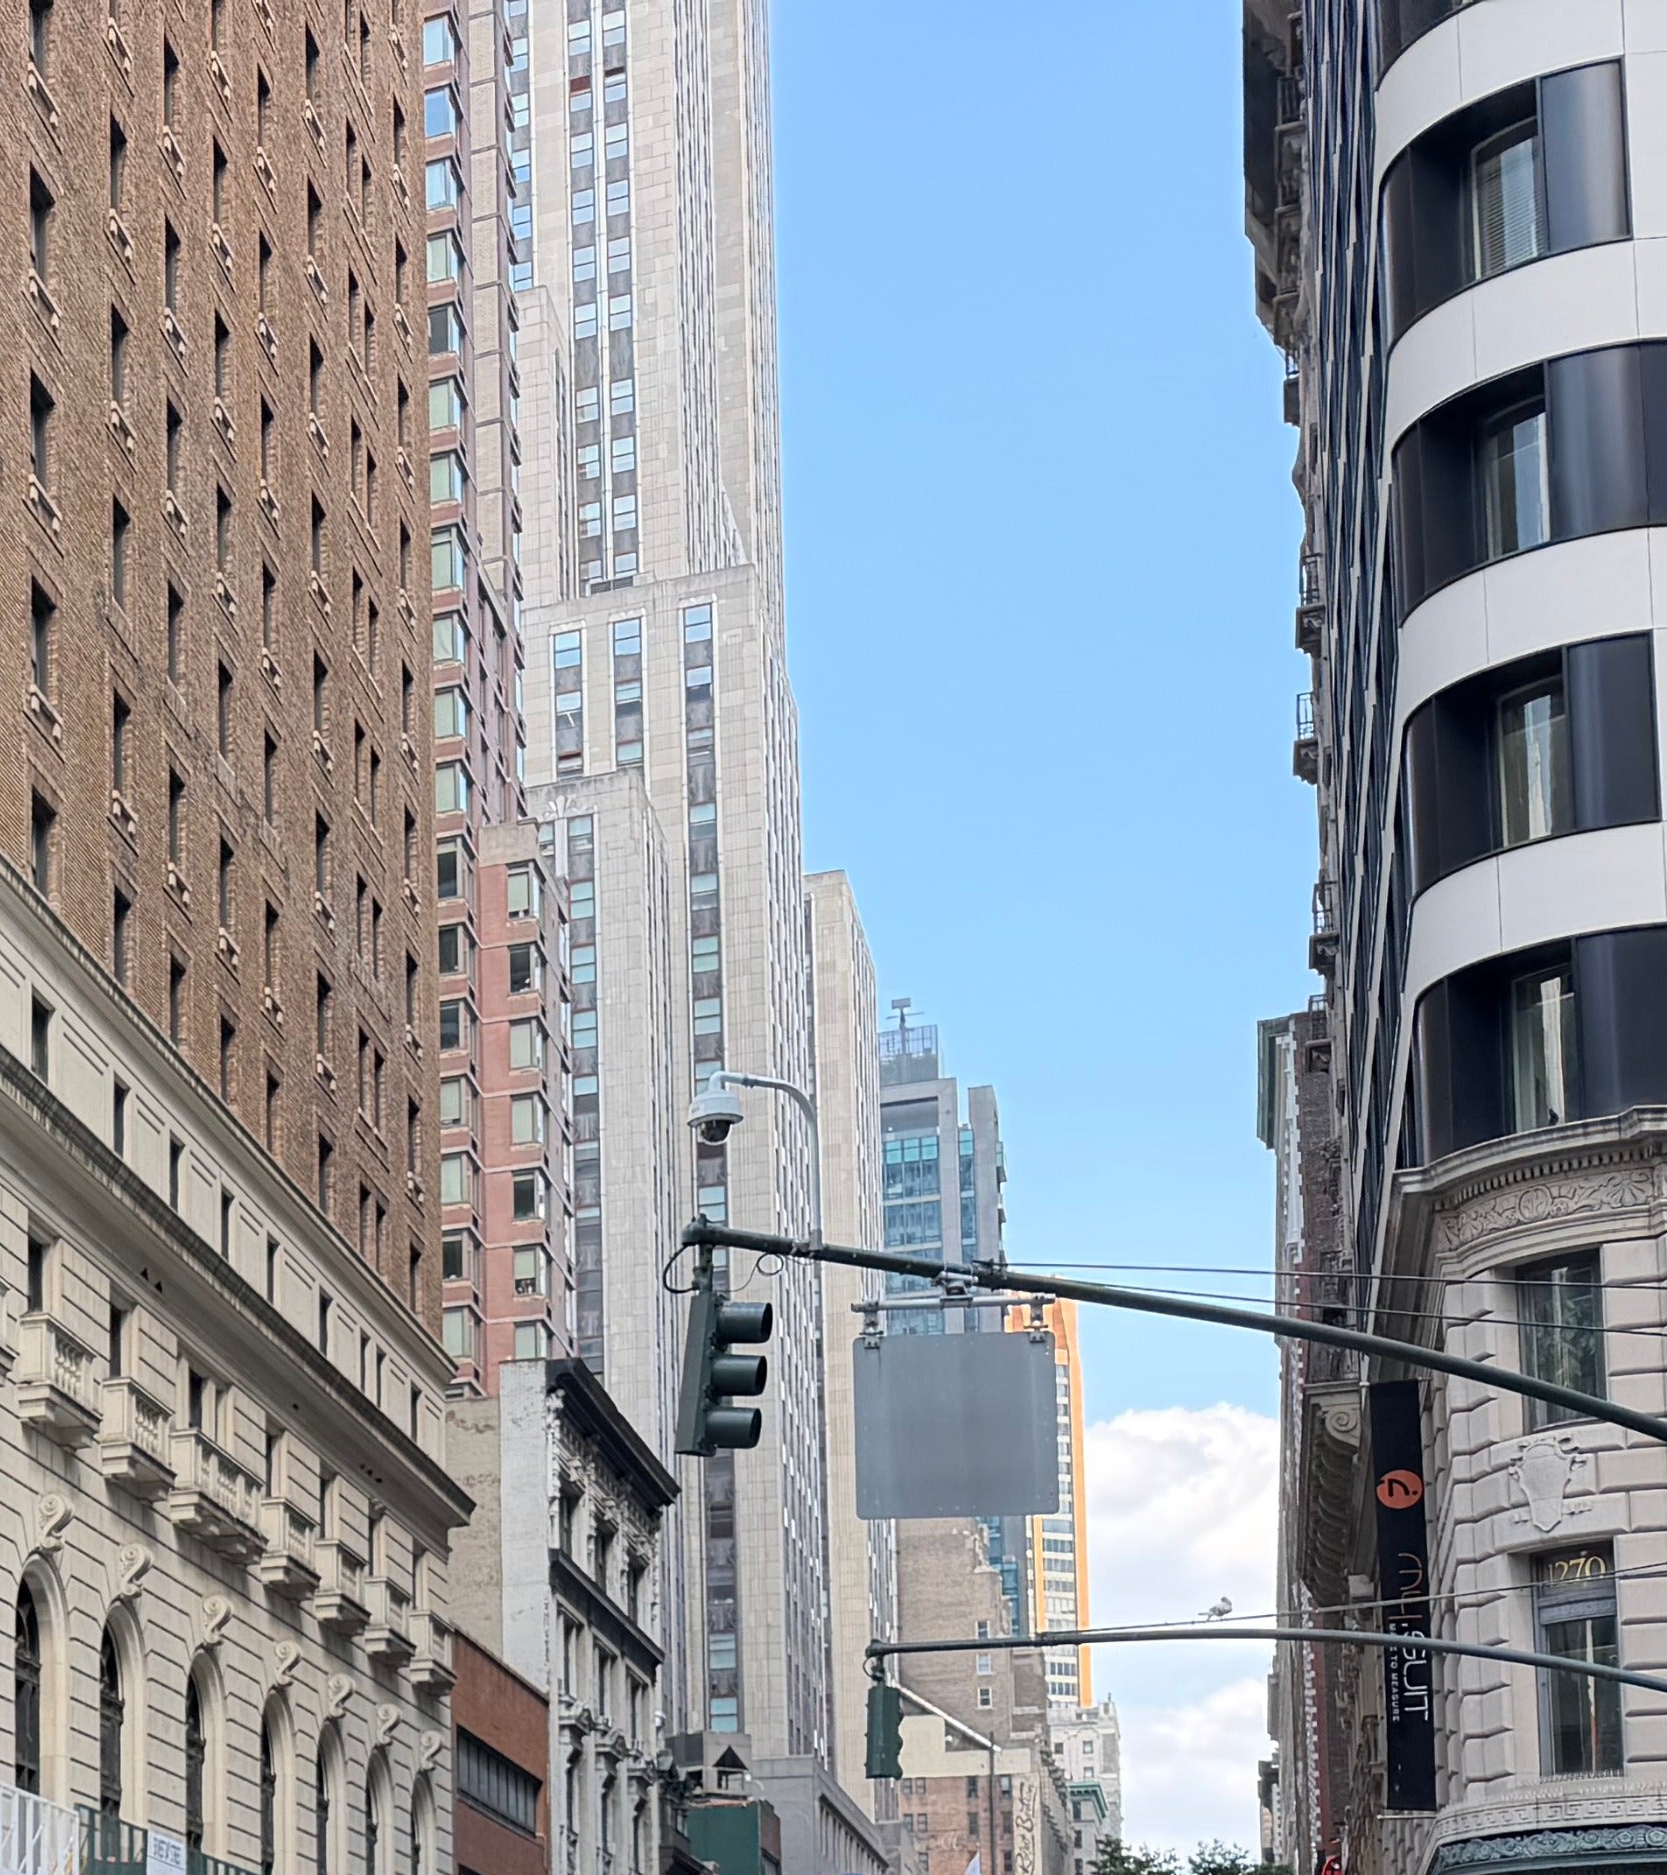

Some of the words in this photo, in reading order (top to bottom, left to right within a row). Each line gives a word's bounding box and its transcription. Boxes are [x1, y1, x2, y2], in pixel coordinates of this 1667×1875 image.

[1548, 1556, 1606, 1587] 1270
[1389, 1656, 1398, 1669] TO
[1390, 1672, 1400, 1722] MEASURE
